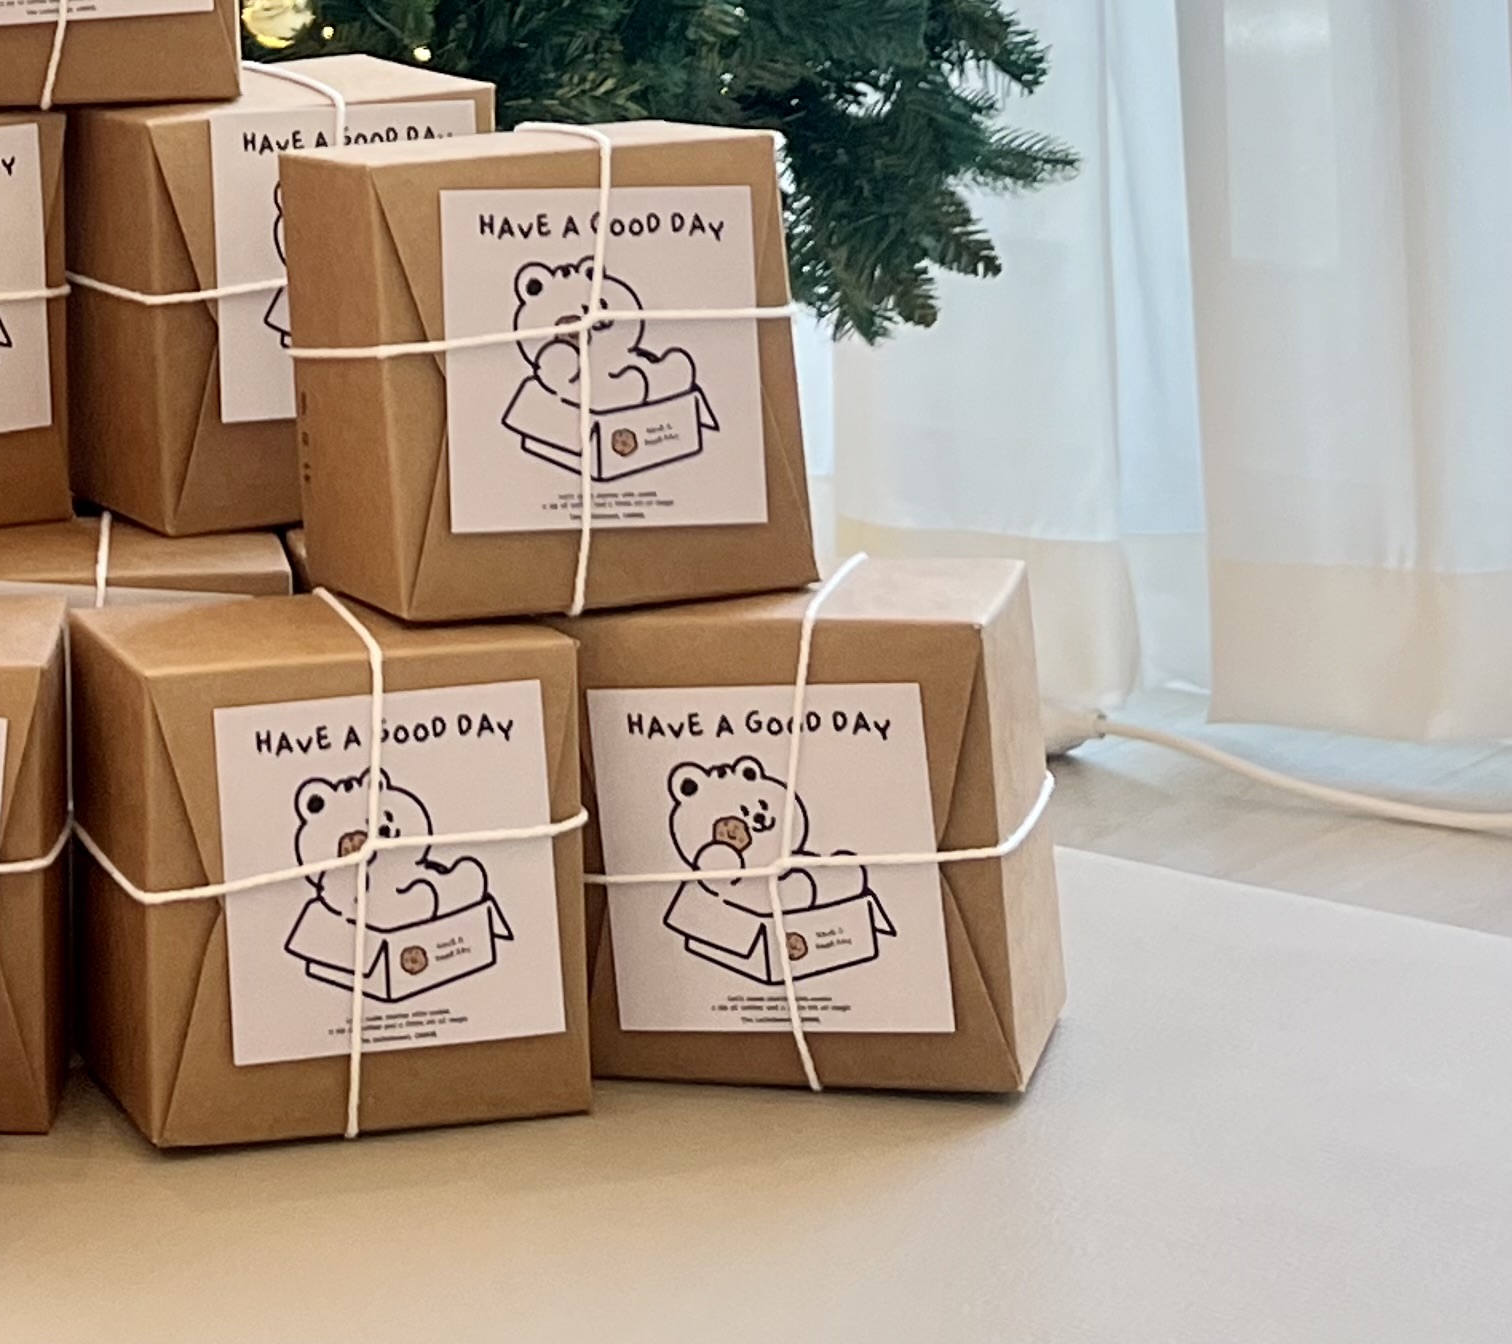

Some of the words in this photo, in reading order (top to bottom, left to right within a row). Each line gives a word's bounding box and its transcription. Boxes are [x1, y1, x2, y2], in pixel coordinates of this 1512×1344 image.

[243, 129, 305, 156] HAVE
[315, 130, 329, 148] A
[406, 125, 453, 142] DA
[479, 213, 551, 240] HAVE
[562, 215, 580, 238] A
[671, 212, 724, 242] DAY
[255, 725, 331, 756] HAVE
[344, 725, 361, 751] A
[457, 713, 513, 741] DAY
[627, 712, 703, 739] HAVE
[716, 714, 734, 738] A
[832, 711, 890, 741] DAY
